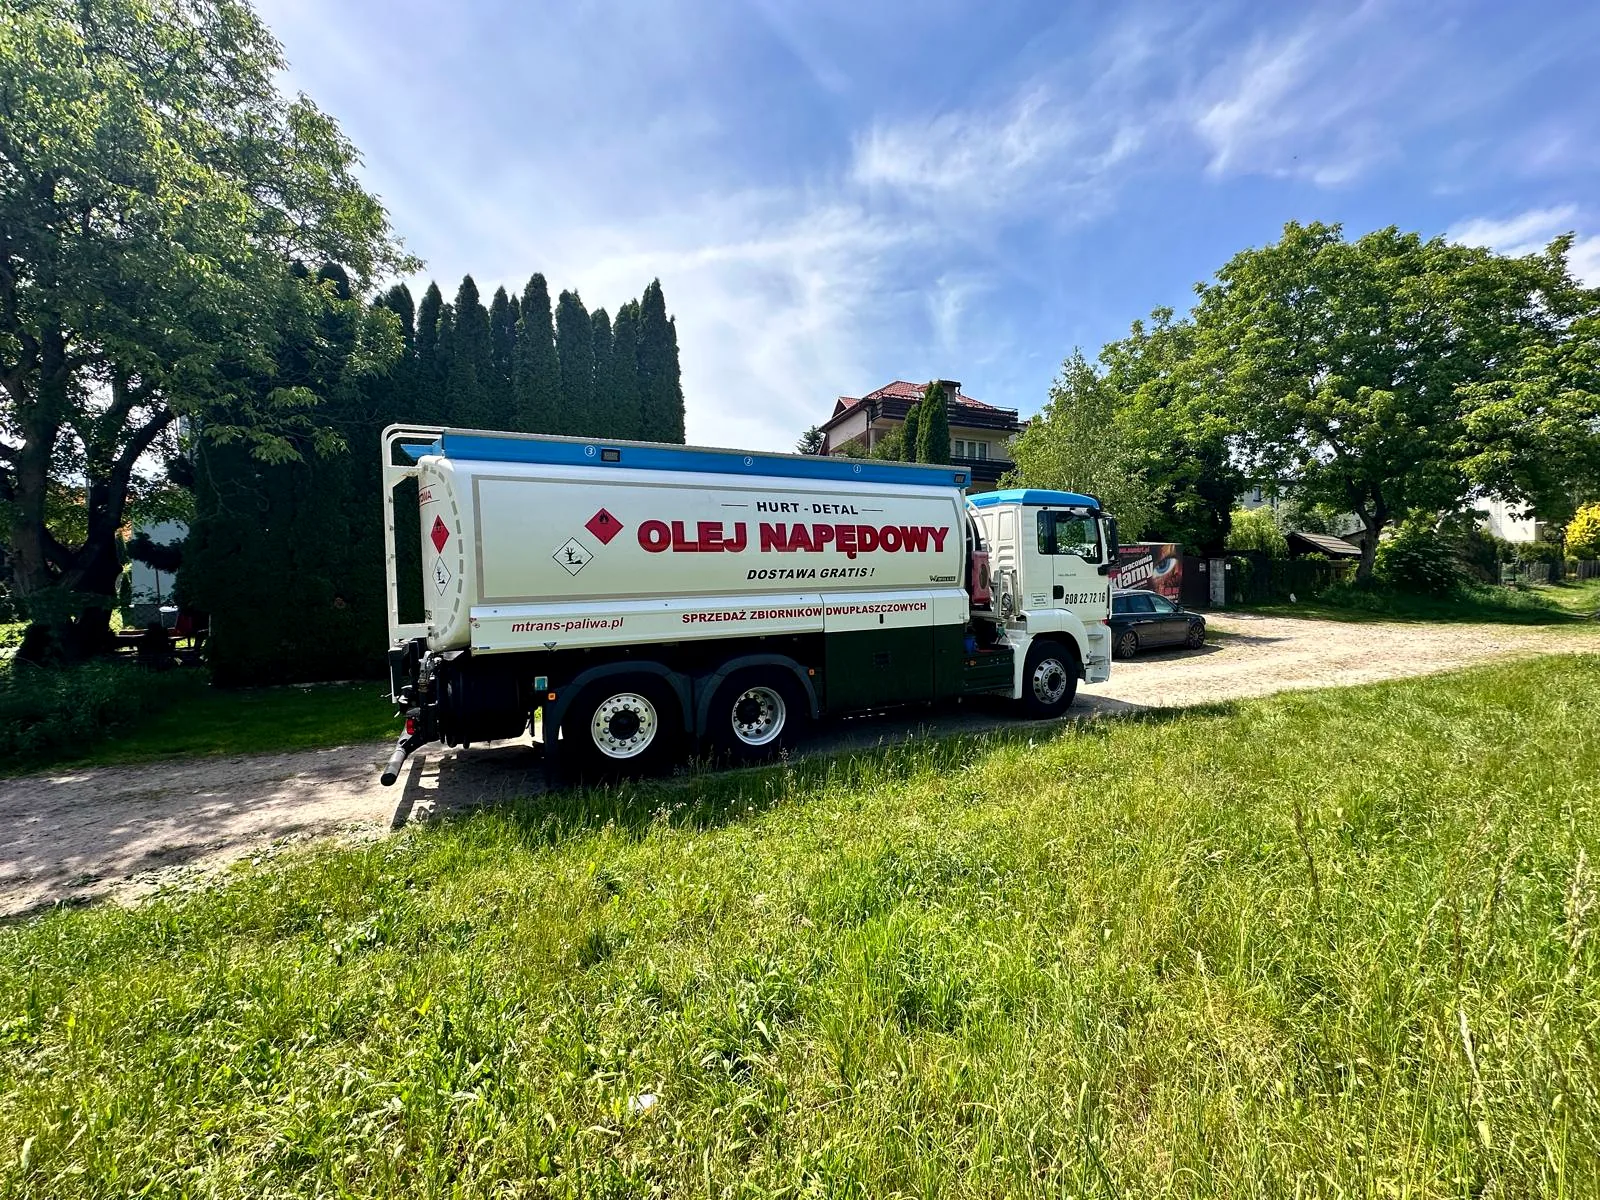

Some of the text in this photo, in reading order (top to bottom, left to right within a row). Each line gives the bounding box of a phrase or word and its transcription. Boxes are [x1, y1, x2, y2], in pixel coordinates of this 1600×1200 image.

[756, 501, 800, 513] HURT
[812, 503, 859, 515] DETAL
[637, 520, 950, 560] OLEJ NAPĘDOWY
[1121, 554, 1153, 573] pracownia
[746, 567, 816, 580] DOSTAWA
[819, 567, 868, 579] GRATIS
[1064, 592, 1105, 605] 608 22 72 16
[681, 602, 927, 624] SPRZEDAŻ ZBIORNIKÓW DWUPŁASZCZOWYCH
[512, 617, 624, 632] mtrans-paliwa.pl
